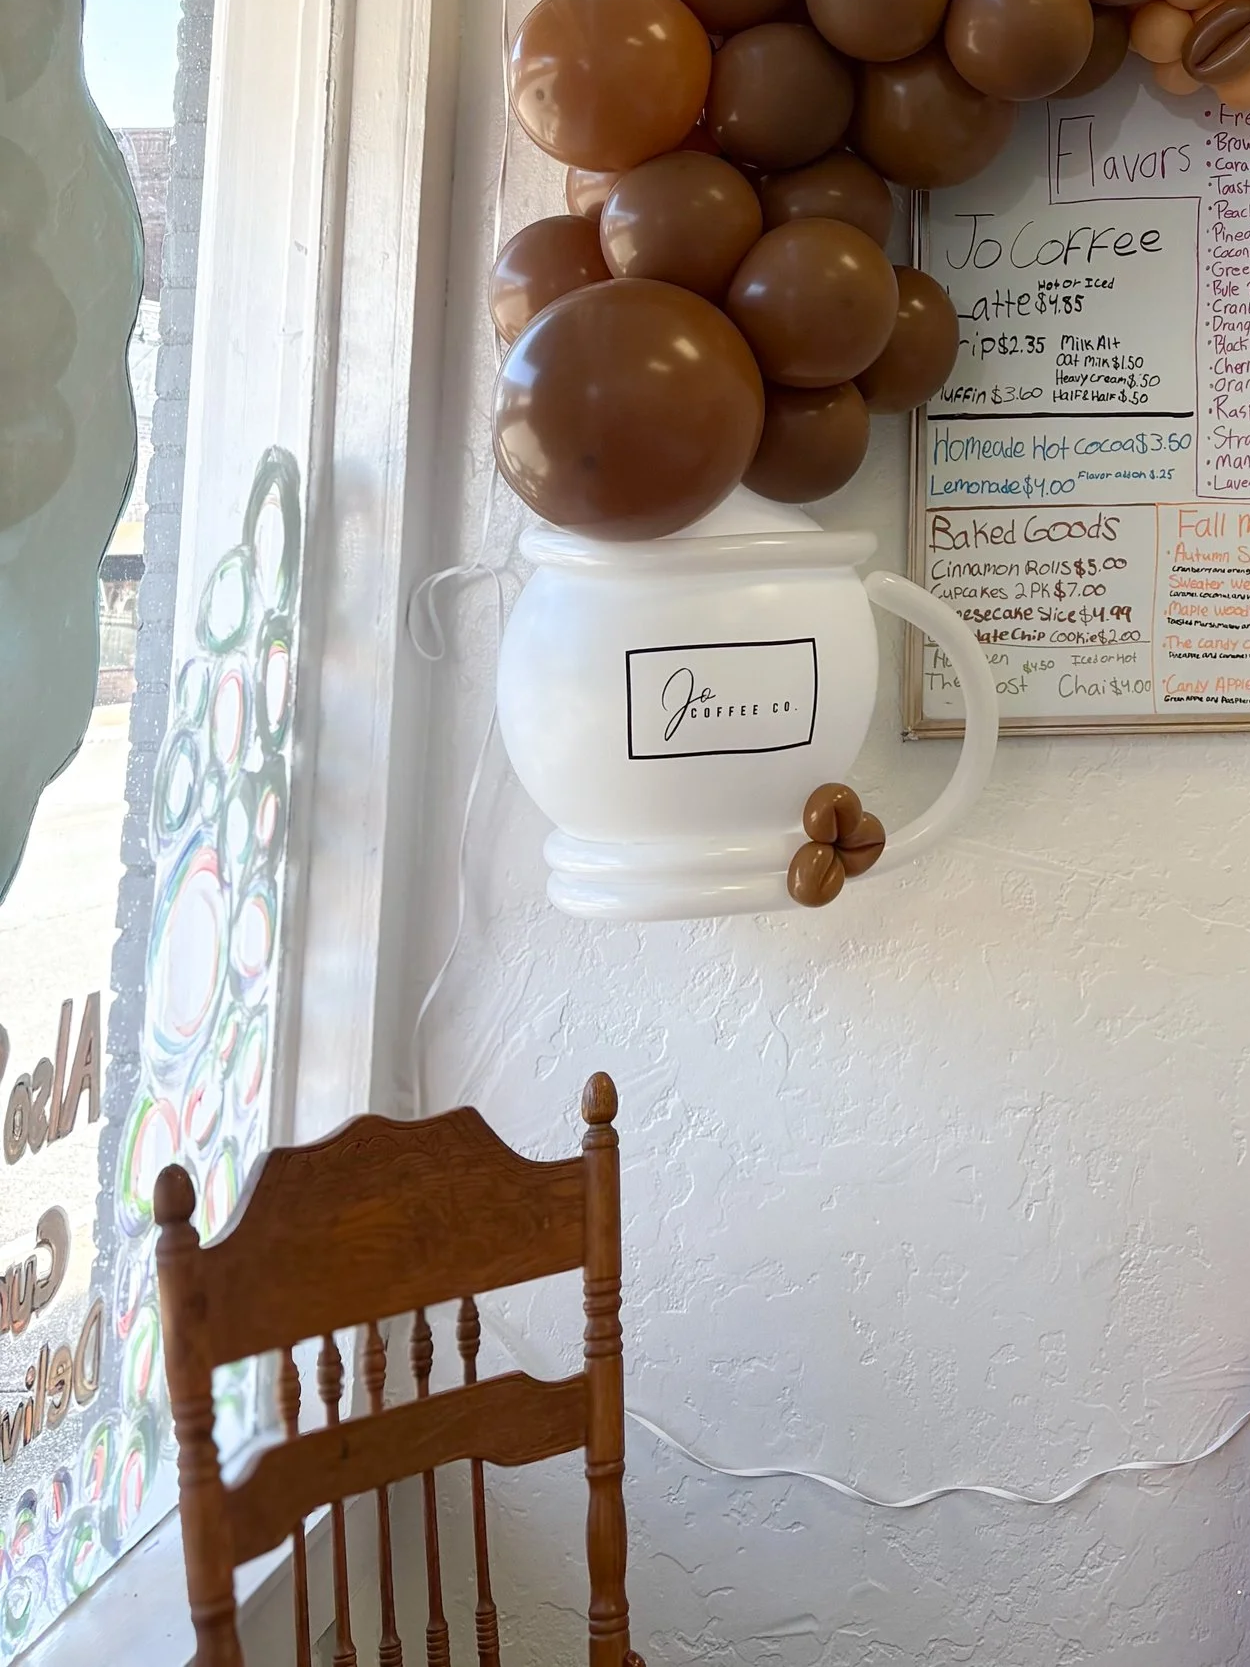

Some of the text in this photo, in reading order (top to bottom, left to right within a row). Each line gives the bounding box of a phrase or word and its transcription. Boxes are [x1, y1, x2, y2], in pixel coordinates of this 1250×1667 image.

[1056, 115, 1191, 194] Flavors
[1032, 435, 1069, 461] Hot
[929, 515, 1016, 553] Baked
[1178, 510, 1226, 539] Fall
[931, 559, 1019, 580] Cinnamon
[1074, 557, 1128, 578] $5.00
[661, 667, 716, 741] Jo
[691, 701, 798, 718] COFFEE CO.
